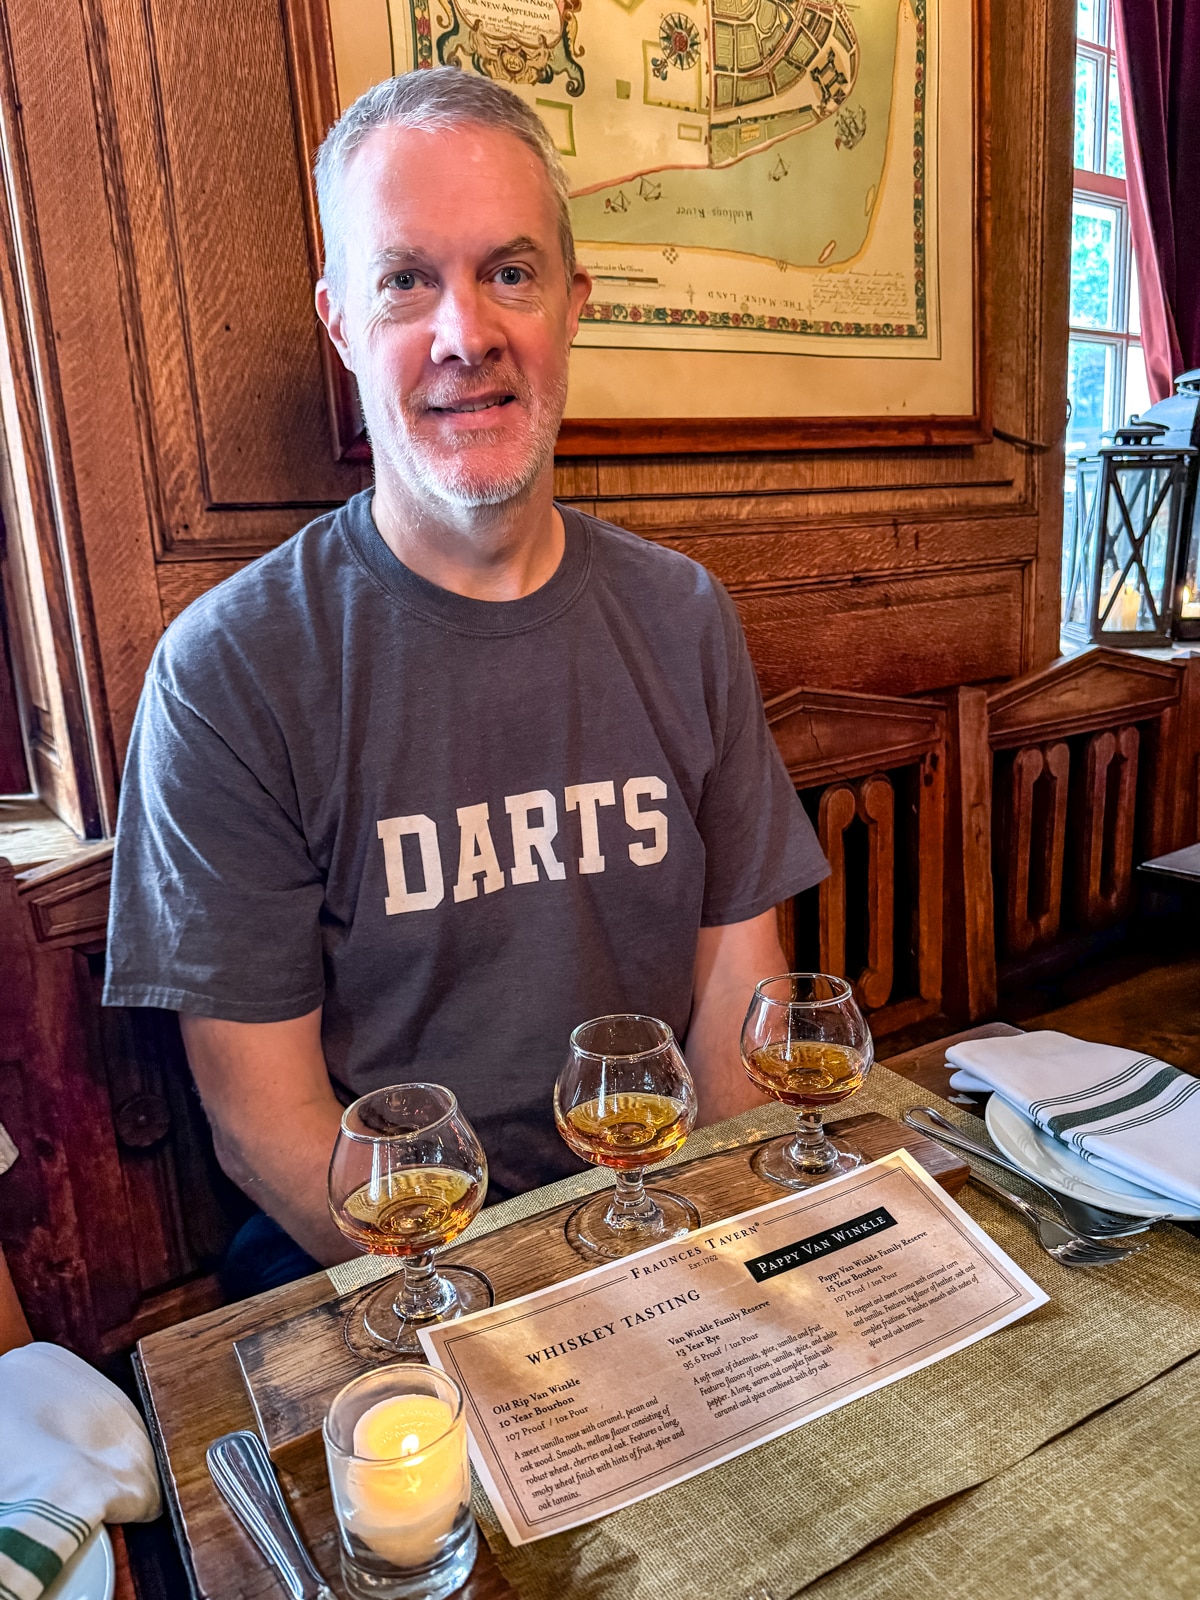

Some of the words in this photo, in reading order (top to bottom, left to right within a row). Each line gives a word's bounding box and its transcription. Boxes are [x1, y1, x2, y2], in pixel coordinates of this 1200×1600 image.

[501, 2, 550, 21] AMSTERDAM
[676, 205, 706, 219] River
[376, 775, 668, 916] DARTS
[758, 1251, 799, 1273] PAPPY
[801, 1239, 831, 1254] VAN
[831, 1216, 886, 1242] WINKLE
[817, 1271, 841, 1283] Pappy
[838, 1265, 855, 1274] Van
[852, 1254, 879, 1267] Winkle
[877, 1243, 903, 1257] Family
[900, 1231, 928, 1246] Reserve
[630, 1247, 702, 1279] FRAUNCES
[702, 1254, 719, 1265] 1762
[964, 1262, 976, 1273] and
[825, 1284, 836, 1293] 15
[833, 1278, 852, 1288] Year
[850, 1265, 883, 1281] Bourbon
[933, 1275, 956, 1288] leather,
[954, 1268, 966, 1278] oak
[834, 1294, 847, 1303] 107
[845, 1284, 866, 1298] Proof
[880, 1271, 898, 1282] Pour
[845, 1310, 855, 1318] An
[854, 1300, 874, 1314] elegant
[873, 1294, 885, 1305] and
[883, 1289, 899, 1300] sweet
[897, 1282, 916, 1294] aroma
[914, 1275, 928, 1286] with
[926, 1264, 947, 1280] caramel
[946, 1260, 959, 1270] corn
[904, 1294, 916, 1303] big
[914, 1287, 930, 1302] flavor
[929, 1281, 940, 1293] of
[860, 1323, 883, 1337] complex
[880, 1312, 908, 1330] fruitiness.
[906, 1302, 929, 1315] Finishes
[927, 1291, 947, 1305] smooth
[946, 1285, 959, 1296] with
[957, 1279, 972, 1290] notes
[971, 1273, 979, 1284] of
[863, 1309, 885, 1322] vanilla.
[882, 1299, 907, 1313] Features
[526, 1323, 614, 1364] WHISKEY
[620, 1290, 700, 1328] TASTING
[667, 1336, 686, 1345] Van
[684, 1323, 714, 1338] Winkle
[713, 1312, 741, 1327] Family
[740, 1301, 770, 1316] Reserve
[797, 1328, 812, 1339] and
[807, 1323, 824, 1337] fruit.
[853, 1316, 865, 1327] and
[868, 1337, 883, 1349] spice
[881, 1329, 894, 1341] and
[892, 1325, 904, 1336] oak
[902, 1318, 925, 1331] tannins.
[675, 1348, 687, 1357] 13
[685, 1341, 705, 1352] Year
[704, 1335, 721, 1345] Rye
[682, 1355, 701, 1371] 95.6
[700, 1346, 722, 1361] Proof
[740, 1333, 759, 1344] Pour
[760, 1345, 778, 1358] spice,
[777, 1335, 798, 1348] vanilla
[699, 1381, 726, 1396] Features
[724, 1372, 747, 1388] flavors
[746, 1365, 756, 1378] of
[753, 1361, 773, 1373] cocoa,
[772, 1350, 796, 1364] vanilla,
[794, 1343, 812, 1356] spice,
[811, 1334, 823, 1346] and
[822, 1330, 838, 1341] white
[711, 1367, 726, 1378] nose
[725, 1361, 736, 1373] of
[729, 1352, 761, 1369] chestnuts,
[699, 1371, 712, 1384] soft
[706, 1394, 730, 1411] pepper.
[734, 1384, 753, 1394] long,
[751, 1375, 770, 1387] warm
[769, 1367, 782, 1379] and
[781, 1359, 805, 1374] complex
[803, 1350, 821, 1366] finish
[819, 1344, 834, 1356] with
[714, 1400, 739, 1419] caramel
[738, 1394, 752, 1407] and
[751, 1391, 767, 1404] spice
[766, 1375, 795, 1395] combined
[793, 1370, 809, 1382] with
[807, 1367, 818, 1377] dry
[817, 1359, 832, 1371] oak.
[492, 1402, 511, 1415] Old
[511, 1398, 530, 1409] Rip
[529, 1392, 549, 1401] Van
[548, 1378, 580, 1394] Winkle
[499, 1419, 511, 1429] 10
[510, 1412, 533, 1423] Year
[533, 1397, 575, 1416] Bourbon
[505, 1431, 520, 1442] 107
[521, 1420, 546, 1436] Proof
[568, 1406, 588, 1419] Pour
[519, 1461, 534, 1473] oak
[533, 1452, 556, 1468] wood.
[555, 1442, 586, 1459] Smooth,
[586, 1433, 611, 1447] mellow
[608, 1424, 630, 1441] flavor
[631, 1411, 664, 1428] consisting
[662, 1404, 671, 1417] of
[521, 1445, 540, 1458] sweet
[540, 1436, 565, 1451] vanilla
[564, 1431, 581, 1441] nose
[580, 1422, 597, 1435] with
[596, 1410, 626, 1429] caramel,
[625, 1404, 646, 1420] pecan
[645, 1395, 659, 1408] and
[525, 1471, 548, 1485] robust
[548, 1463, 573, 1477] wheat,
[573, 1452, 600, 1467] cherries
[599, 1443, 614, 1457] and
[613, 1438, 630, 1451] oak.
[628, 1428, 657, 1444] Features
[661, 1418, 680, 1429] long,
[531, 1484, 554, 1498] smoky
[554, 1475, 576, 1490] wheat
[575, 1466, 596, 1485] finish
[595, 1460, 612, 1473] with
[610, 1454, 629, 1466] hints
[628, 1446, 638, 1461] of
[635, 1444, 655, 1459] fruit,
[655, 1436, 672, 1450] spice
[671, 1427, 685, 1440] and
[538, 1498, 552, 1511] oak
[552, 1491, 581, 1506] tannins.
